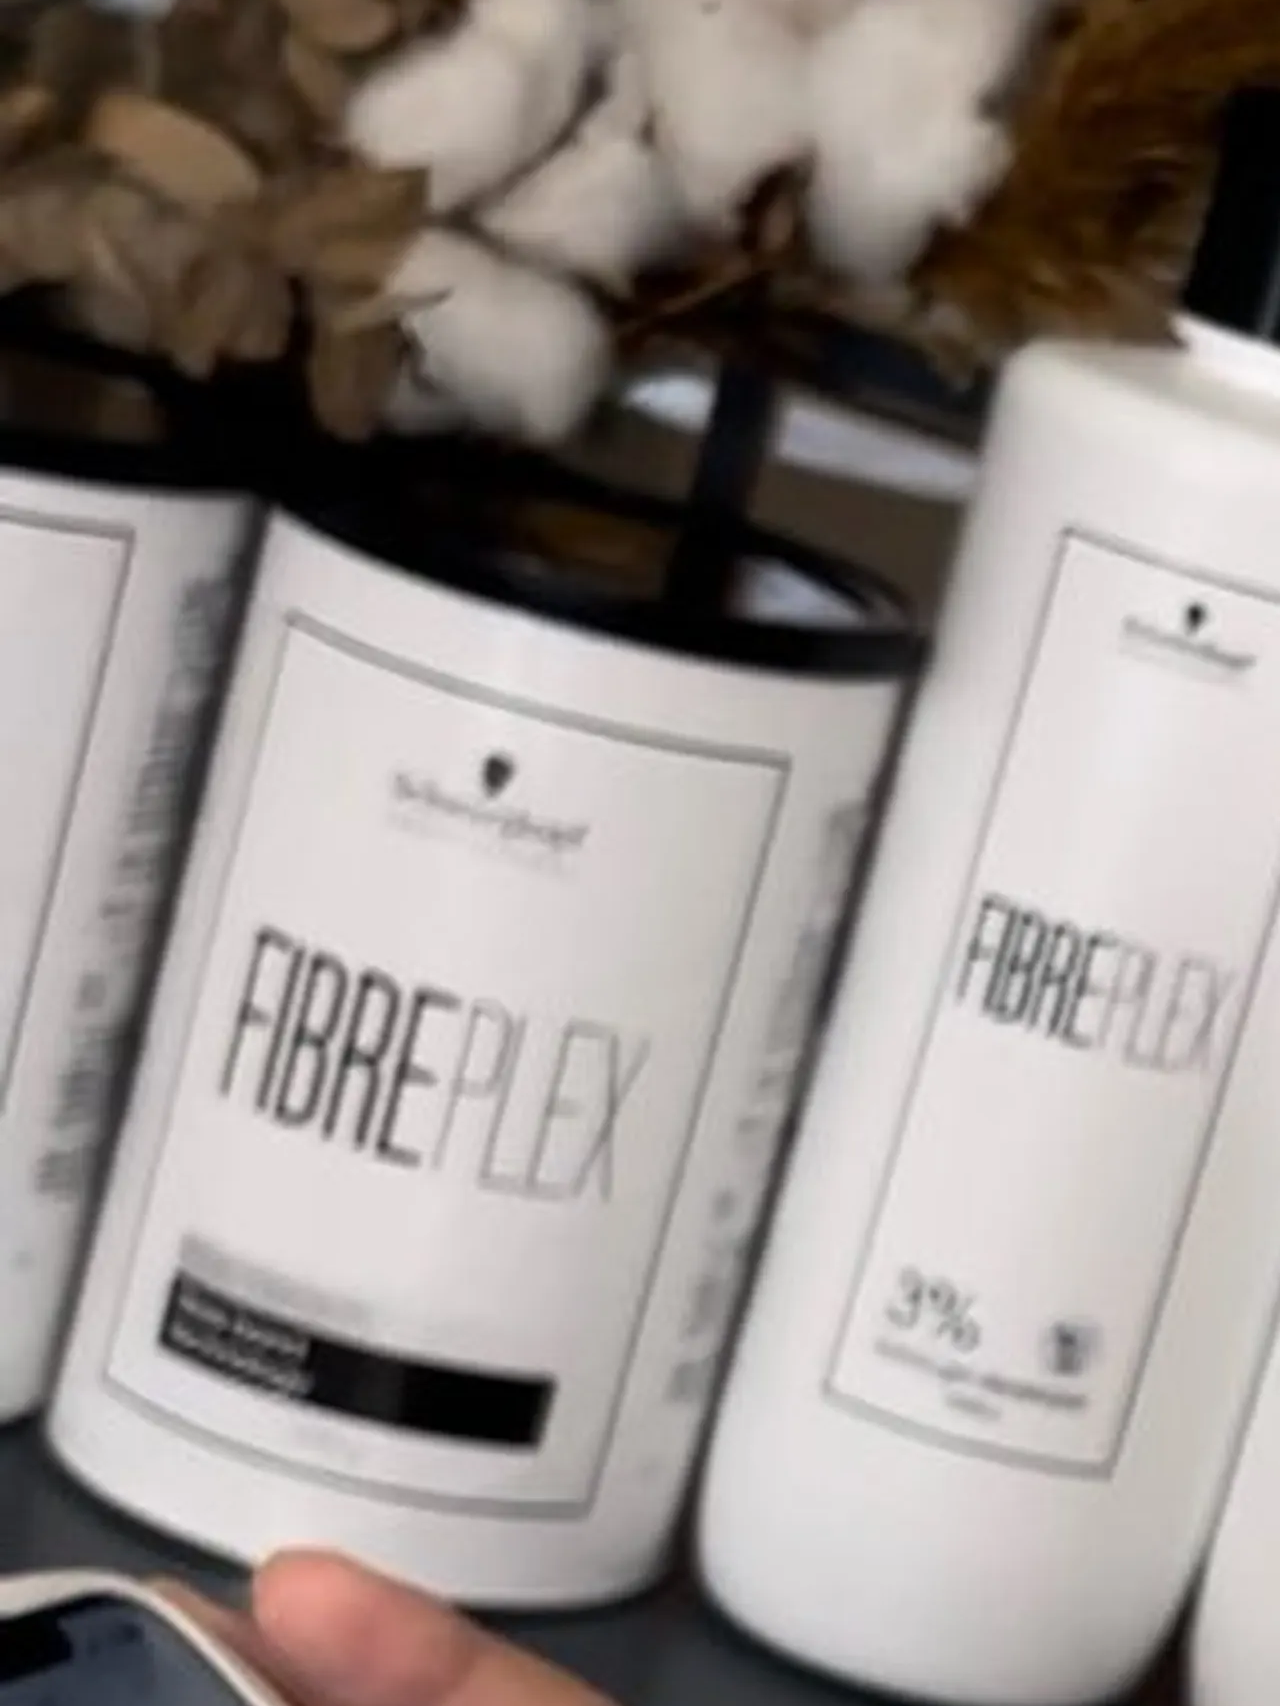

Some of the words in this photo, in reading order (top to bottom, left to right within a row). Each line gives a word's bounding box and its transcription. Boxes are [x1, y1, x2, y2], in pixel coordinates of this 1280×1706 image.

[218, 924, 652, 1203] FIBREPLEX
[954, 891, 1240, 1073] FIBREPLEX
[885, 1264, 981, 1354] 3%
